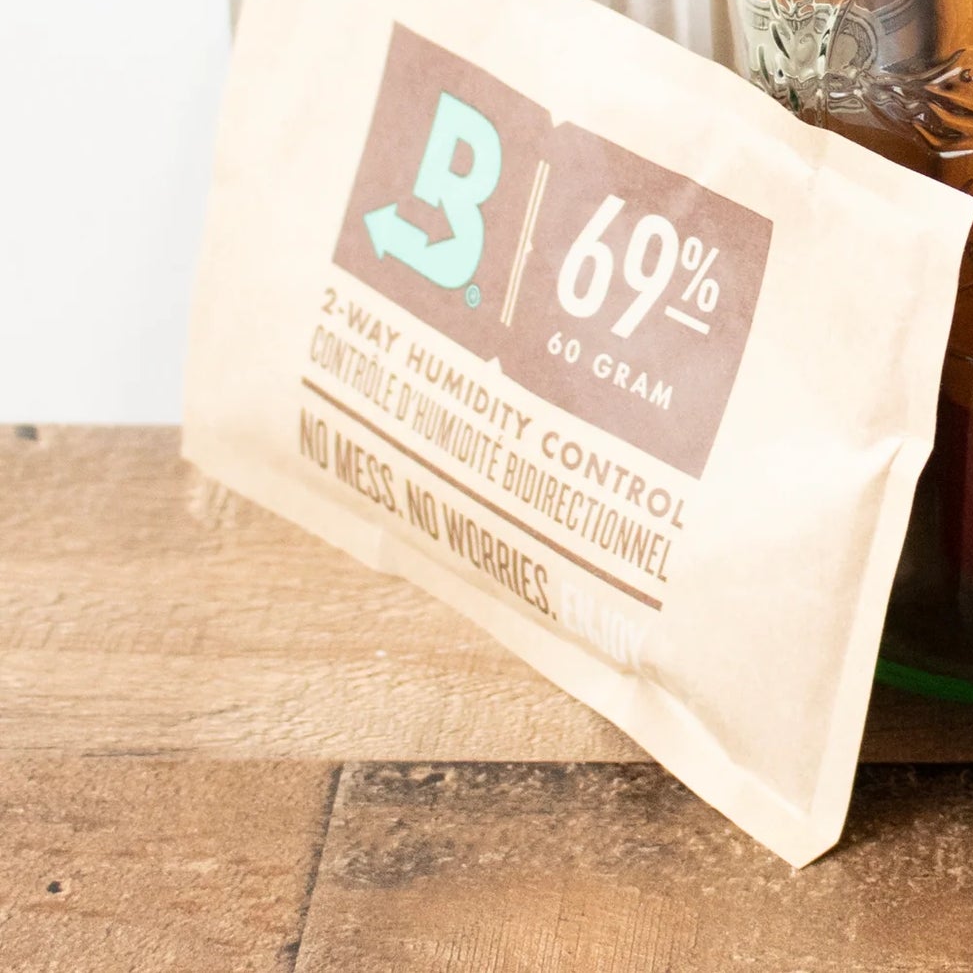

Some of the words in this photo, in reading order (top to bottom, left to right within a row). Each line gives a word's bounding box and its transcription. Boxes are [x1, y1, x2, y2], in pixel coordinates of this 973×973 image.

[547, 330, 582, 364] 60
[592, 354, 674, 411] GRAM
[556, 194, 720, 339] 69%
[299, 408, 330, 469] NO
[335, 427, 404, 518] MESS.
[406, 476, 441, 541] NO
[443, 501, 557, 621] WORRIES.
[309, 323, 397, 417] CONTRÔLE
[501, 457, 675, 584] BIDIRECTIONNEL
[321, 287, 401, 356] 2-WAY
[406, 343, 533, 440] HUMIDITY
[540, 430, 686, 530] CONTROL
